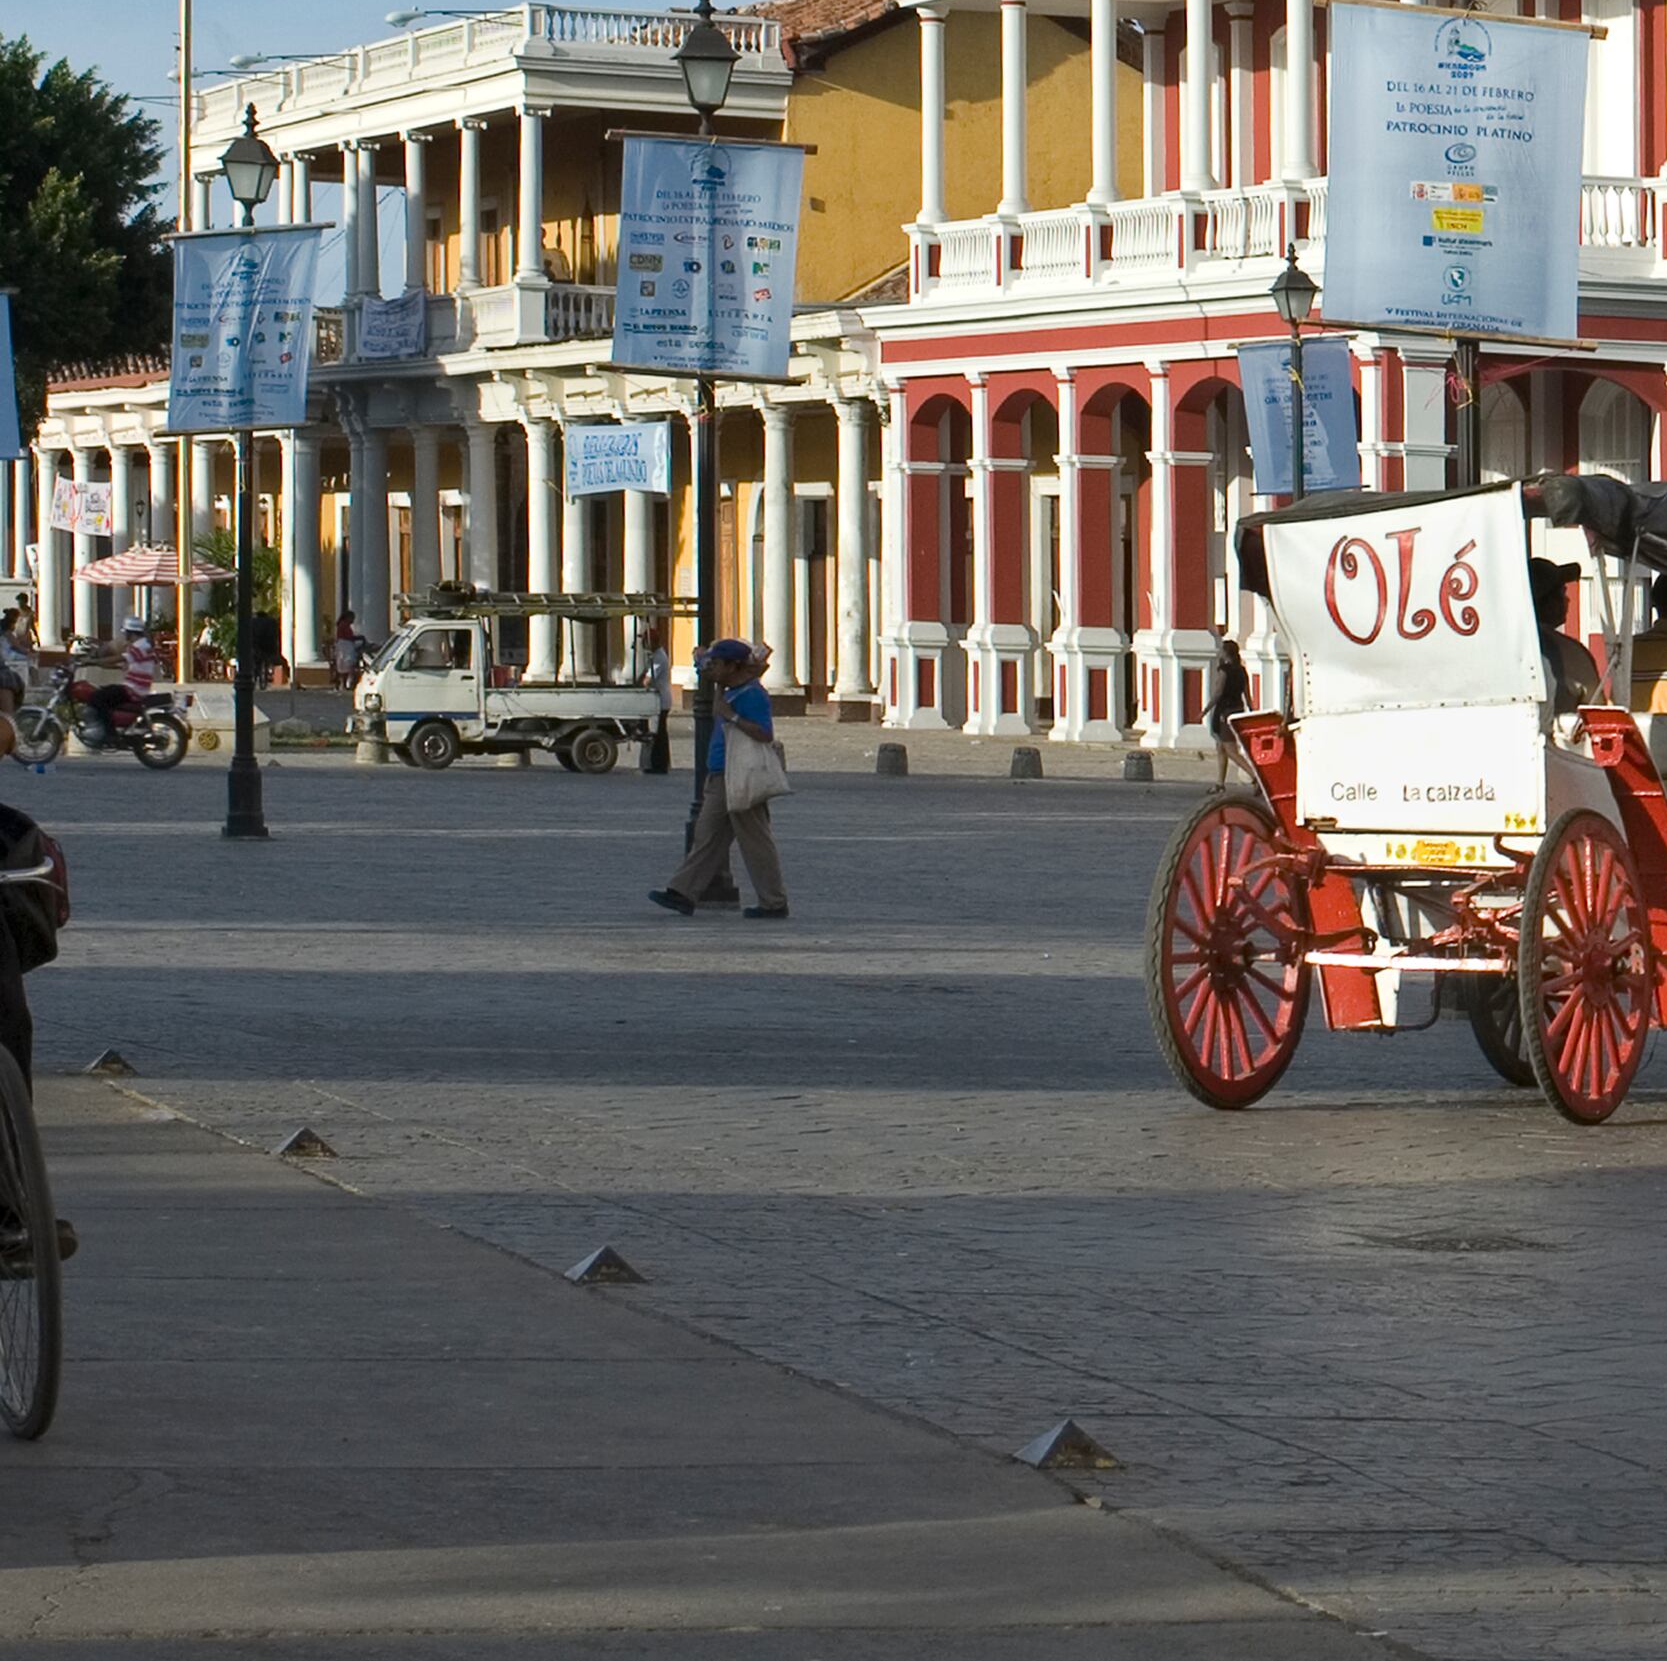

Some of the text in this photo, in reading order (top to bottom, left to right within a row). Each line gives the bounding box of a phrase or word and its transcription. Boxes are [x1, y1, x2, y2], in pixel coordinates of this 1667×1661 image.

[1386, 81, 1535, 102] DEL 16 AL 21 DE FEBRERO
[1386, 121, 1533, 142] PATROCINIO PLATINO
[1395, 308, 1434, 318] FESTIVAL
[1437, 311, 1508, 324] INTERNACIONAL
[1324, 526, 1480, 646] Olé
[1331, 782, 1378, 801] Calle
[1426, 778, 1496, 803] calzada
